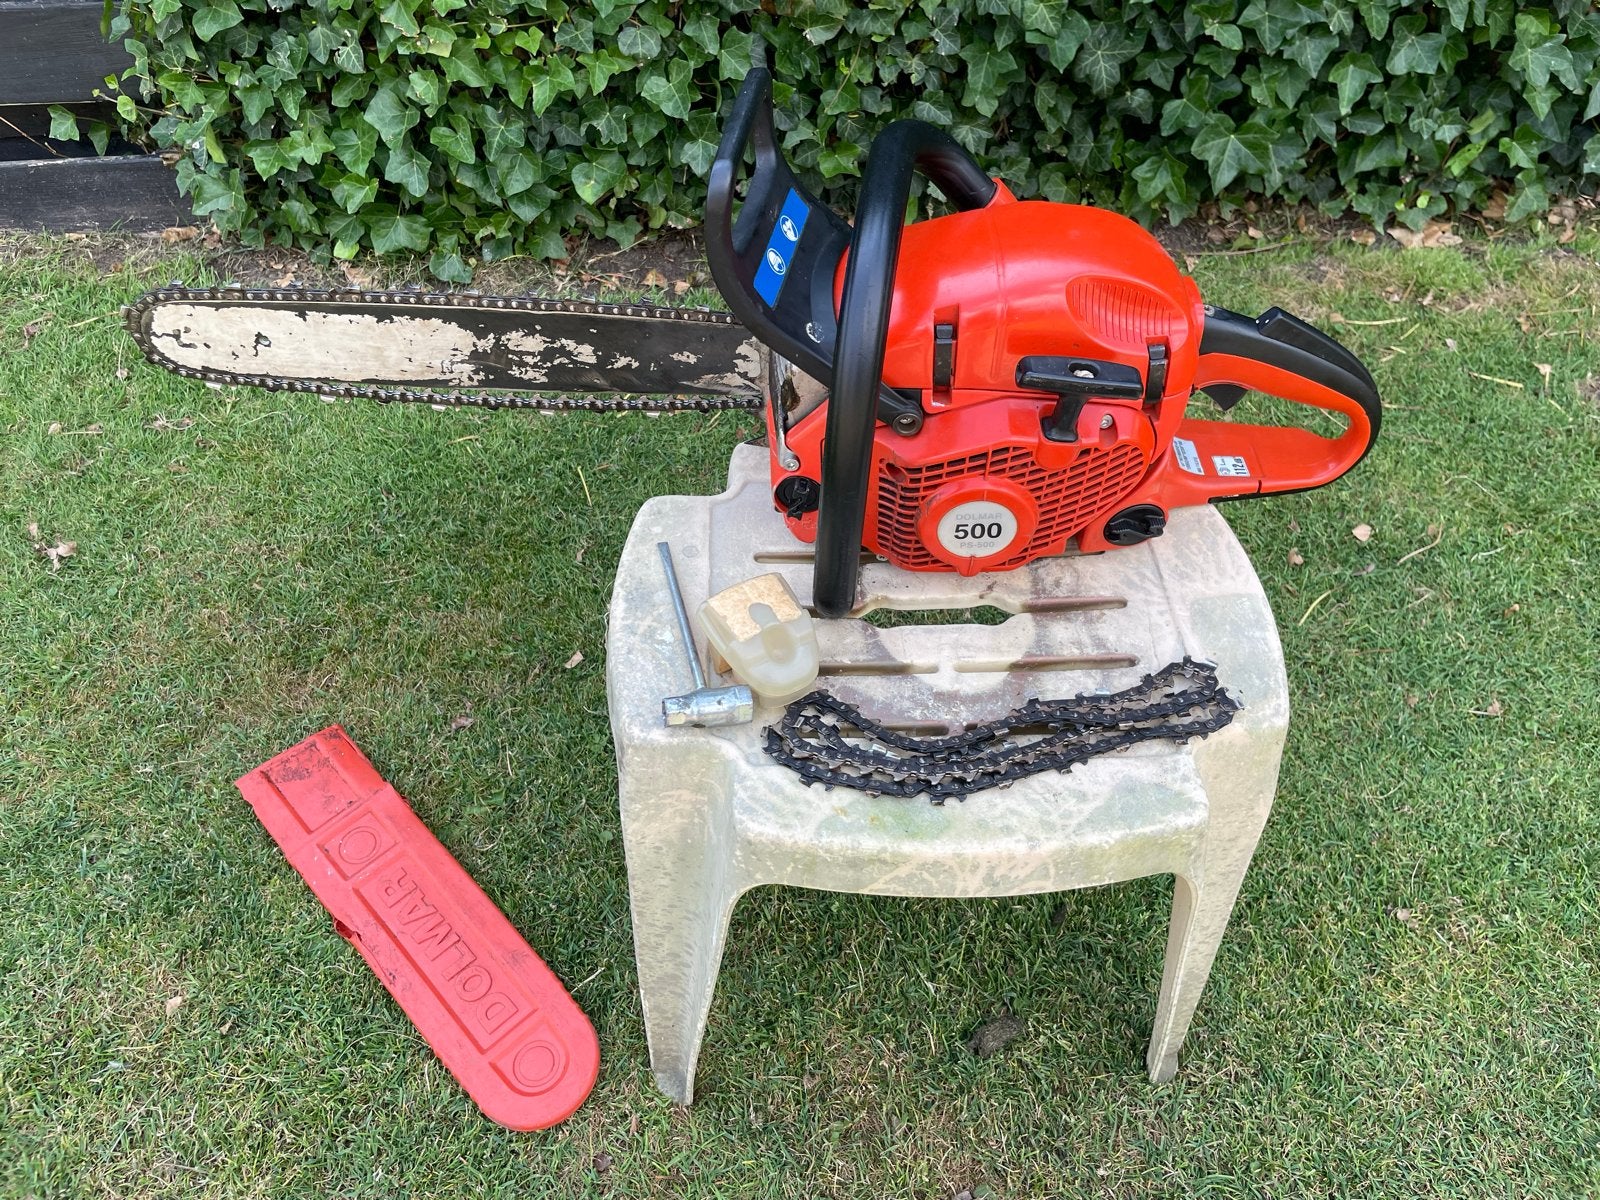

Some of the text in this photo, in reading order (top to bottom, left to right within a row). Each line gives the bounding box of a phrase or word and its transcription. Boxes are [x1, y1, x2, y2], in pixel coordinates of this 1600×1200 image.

[956, 513, 1002, 521] DOLMAR
[954, 523, 1002, 539] 500
[376, 867, 519, 1035] DOLMAR
